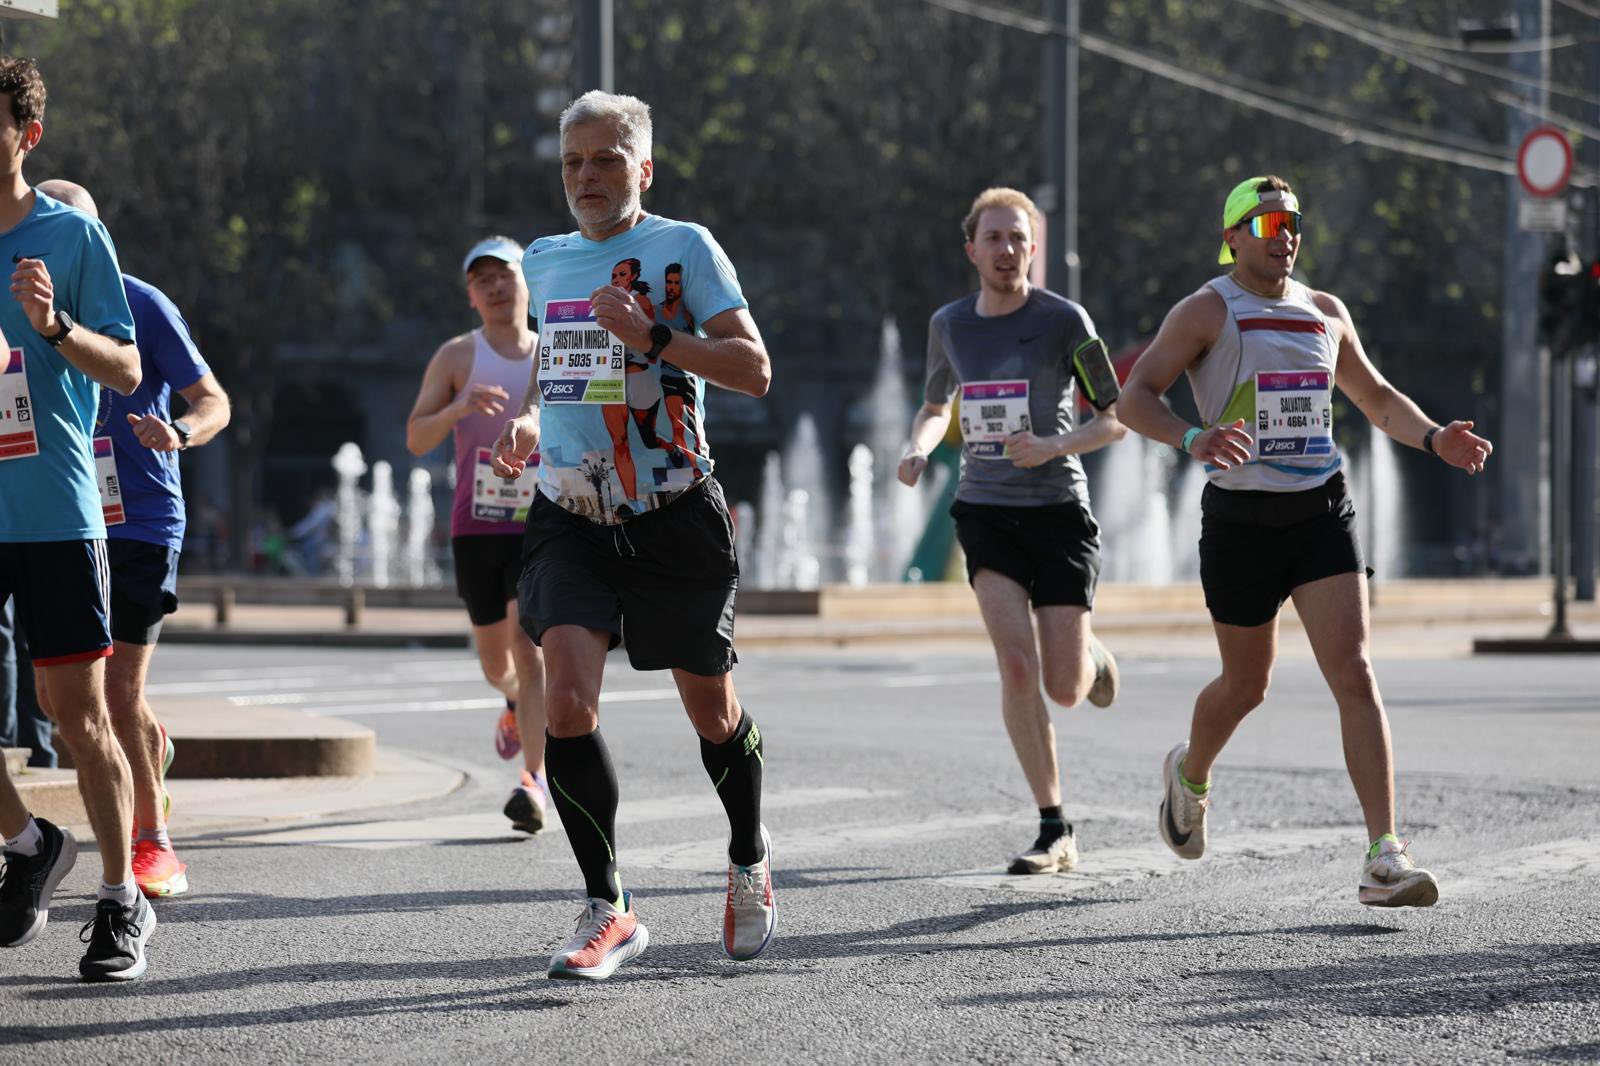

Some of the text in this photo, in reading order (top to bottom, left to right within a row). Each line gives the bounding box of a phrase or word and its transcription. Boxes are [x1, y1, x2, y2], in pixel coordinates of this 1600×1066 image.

[552, 329, 610, 350] CRISTIAN MIRCEA
[568, 353, 592, 367] 5035
[1280, 396, 1312, 413] SALVATORE
[1287, 415, 1307, 428] 4664
